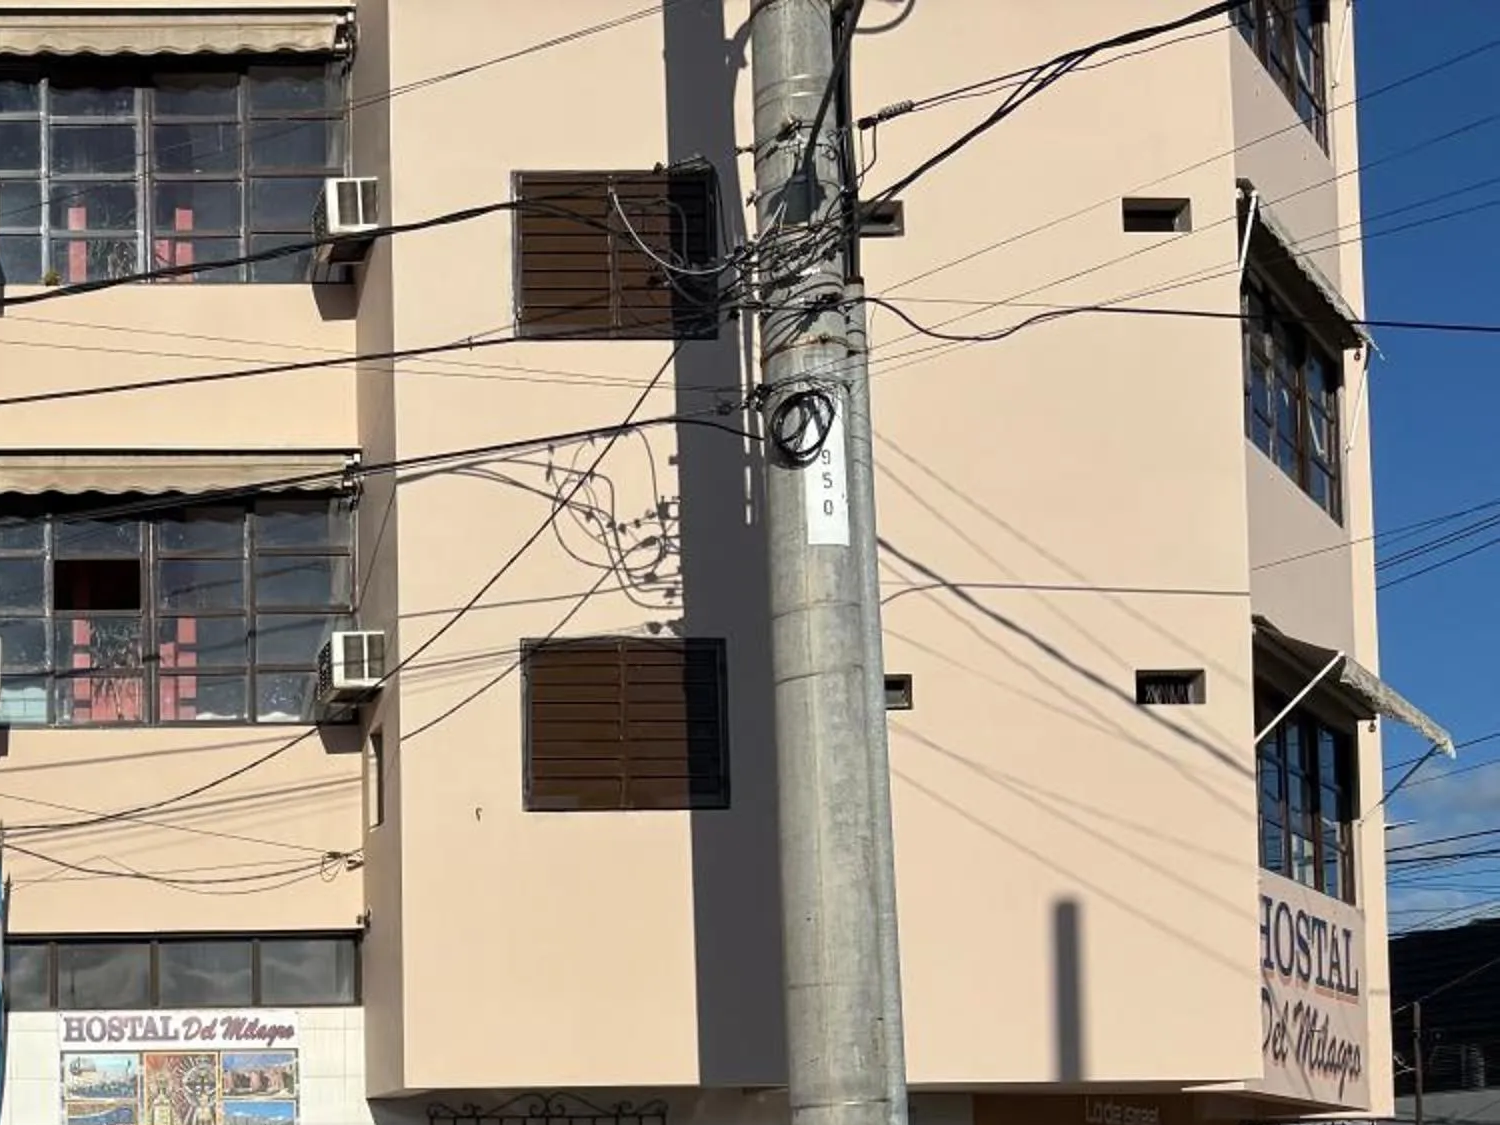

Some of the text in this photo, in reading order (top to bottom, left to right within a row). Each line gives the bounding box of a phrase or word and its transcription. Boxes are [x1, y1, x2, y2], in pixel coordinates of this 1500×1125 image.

[1259, 893, 1360, 1001] HOSTAL
[63, 1015, 296, 1047] HOSTAL Del Milagro
[1293, 1000, 1362, 1099] Milagro
